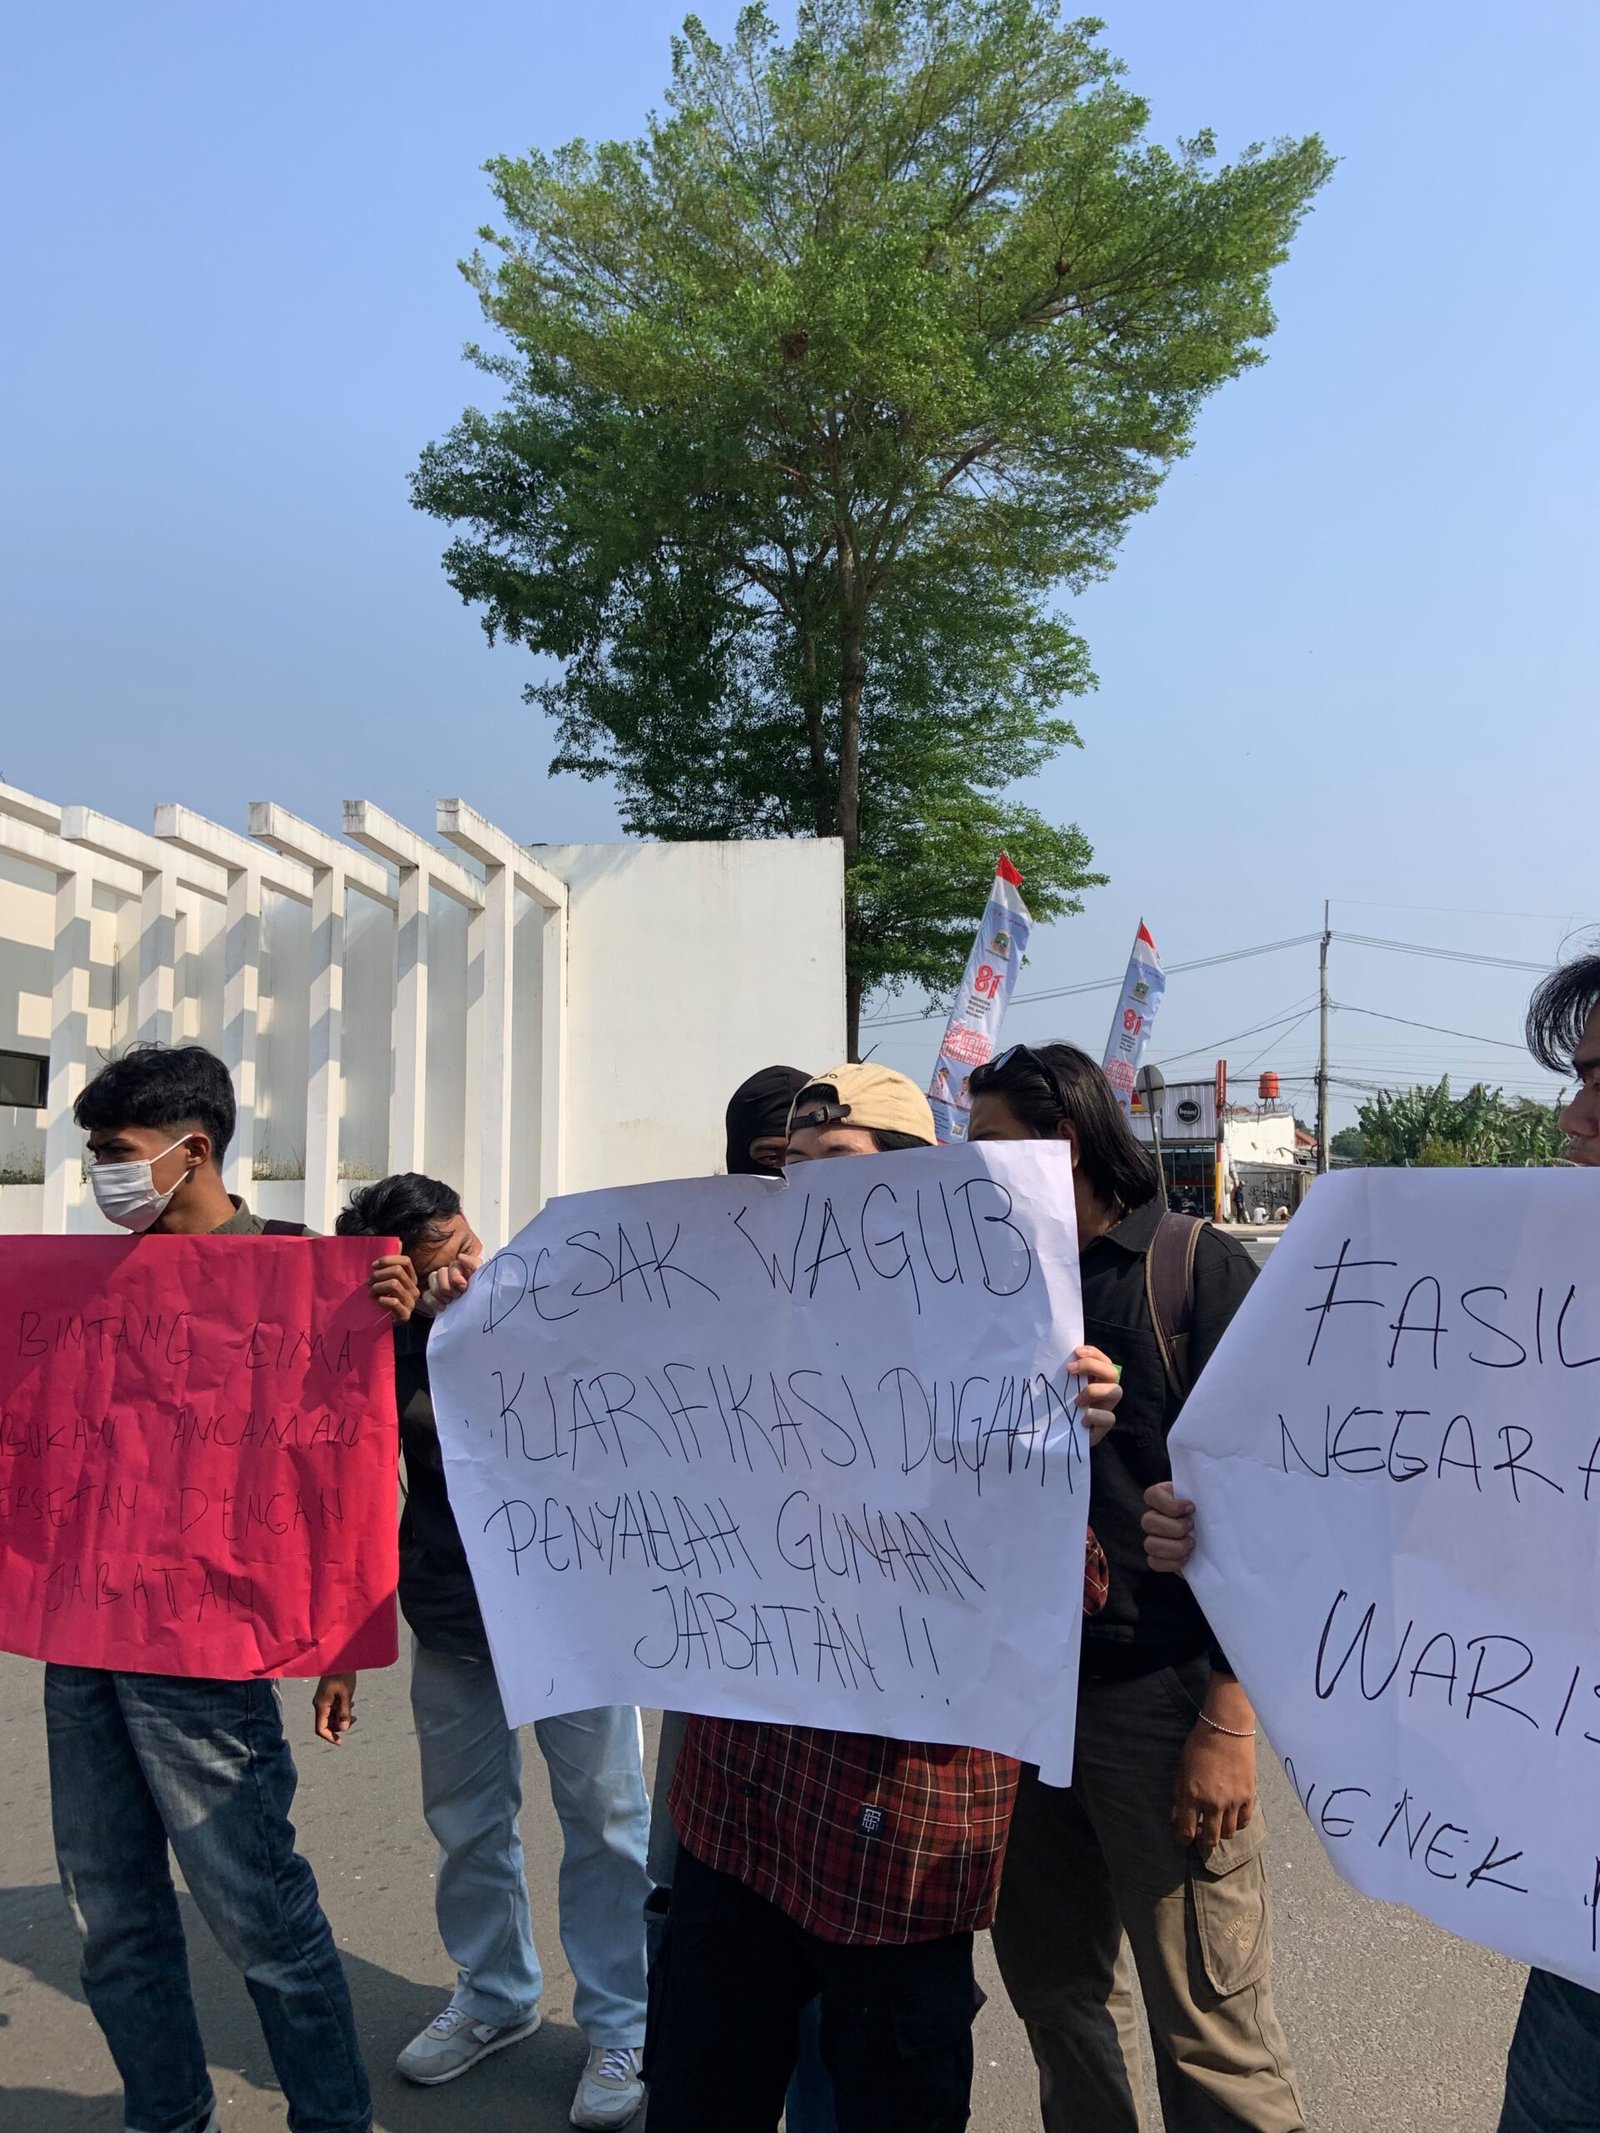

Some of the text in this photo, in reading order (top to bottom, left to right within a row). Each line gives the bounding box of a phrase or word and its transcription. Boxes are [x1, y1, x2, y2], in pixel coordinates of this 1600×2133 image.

[975, 965, 1004, 999] 81
[482, 1178, 1031, 1334] DESAK WAGUB
[18, 1310, 354, 1372] BINTANG LIMA
[0, 1412, 360, 1458] BUKAN ANCAMAN
[491, 1364, 876, 1472] KLARIFIKASI
[179, 1487, 344, 1542] DENGAN
[775, 1490, 986, 1604] GUNAAN
[44, 1562, 256, 1622] JABATAN
[634, 1585, 884, 1691] JABATAN
